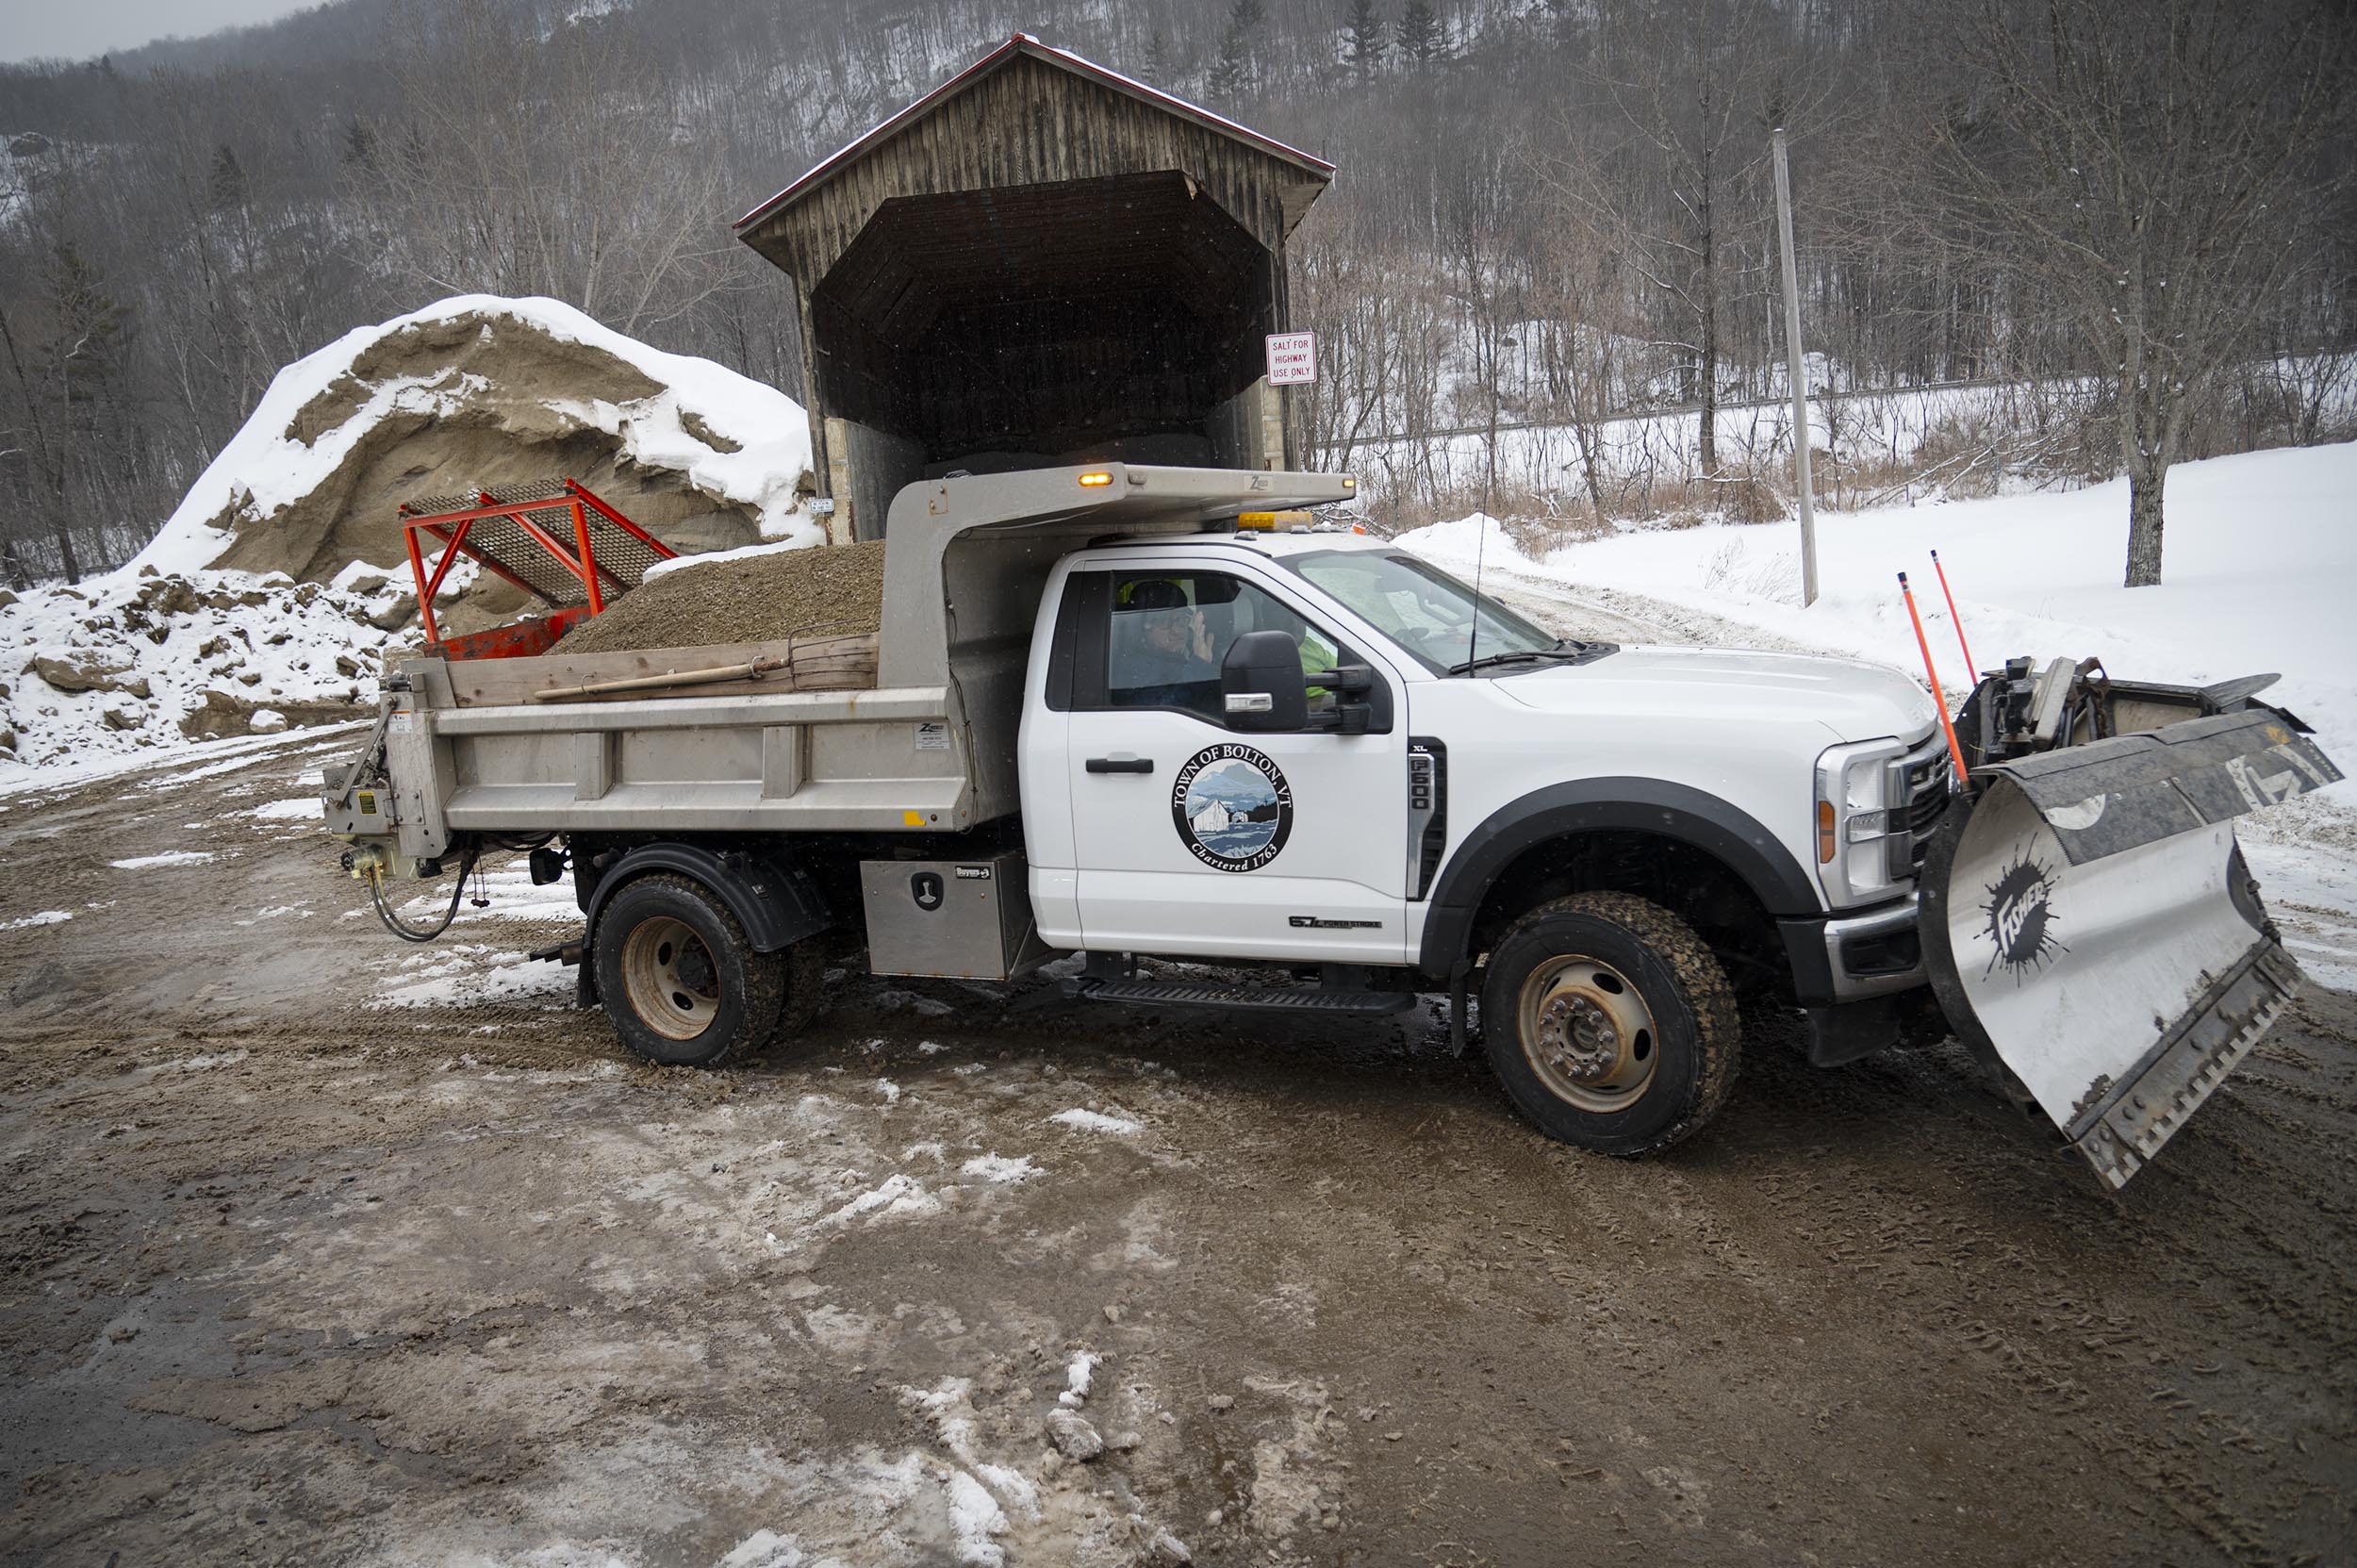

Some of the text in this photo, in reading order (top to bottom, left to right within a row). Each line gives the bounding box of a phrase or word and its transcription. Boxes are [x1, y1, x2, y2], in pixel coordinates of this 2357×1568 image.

[1273, 340, 1309, 351] SALT FOR
[1275, 354, 1307, 364] HIGHWAY
[1274, 367, 1310, 377] USE ONLY
[1174, 745, 1292, 808] TOWN OF BOLTON, VT
[1192, 843, 1277, 871] Chartered 1763
[1997, 881, 2046, 957] FISHER
